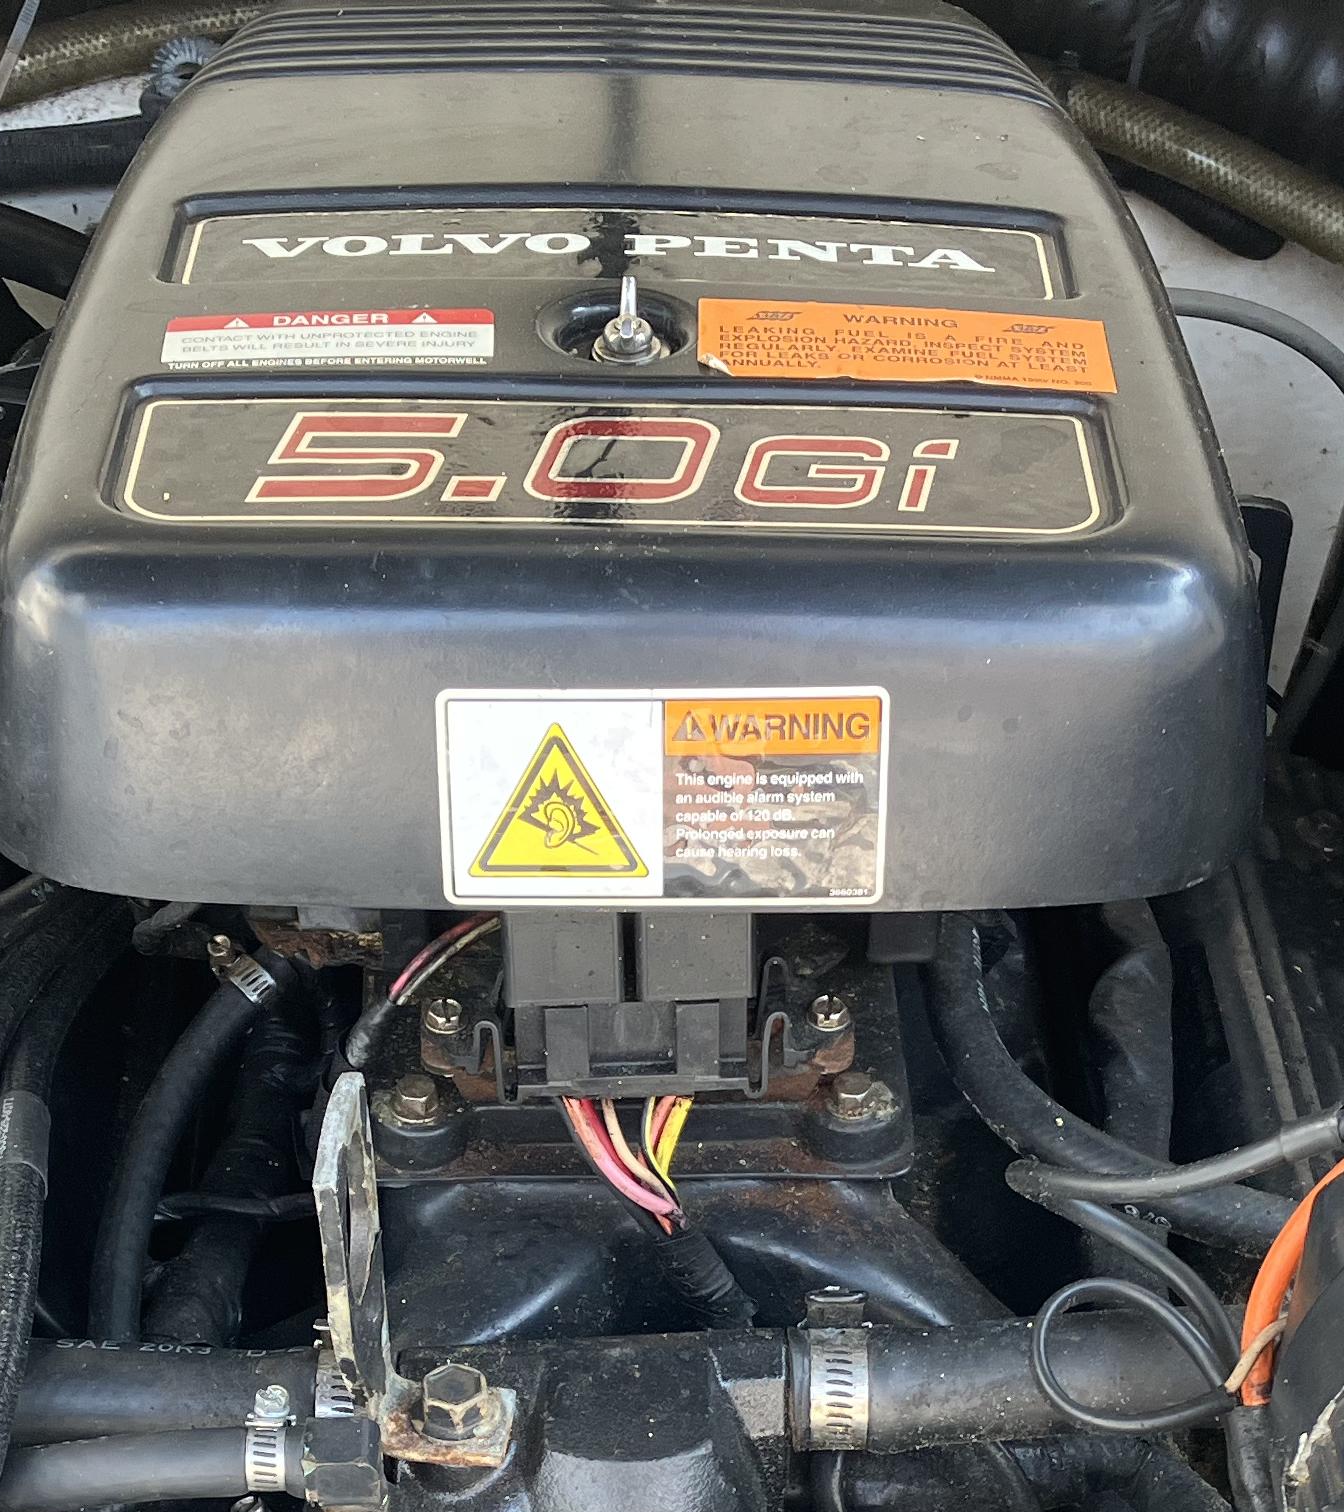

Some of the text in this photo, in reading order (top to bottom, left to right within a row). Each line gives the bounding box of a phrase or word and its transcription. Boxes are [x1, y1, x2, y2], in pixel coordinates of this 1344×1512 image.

[242, 232, 996, 274] VOLVO PENTA
[272, 313, 389, 327] DANGER
[842, 313, 959, 329] WARNING
[181, 330, 478, 345] CONTACT WITH UNPROTECTED ENGINE
[718, 325, 1085, 350] LEAKING FUEL IS A FIRE AND
[719, 333, 828, 346] EXPLOSION
[924, 341, 1002, 353] INSPECT
[1008, 345, 1087, 358] SYSTEM
[181, 339, 476, 354] BELTS WILL RESULT IN SEVERE INJURY
[167, 356, 488, 371] TURN OFF ALL ENGINES BEFORE ENTERING MOTORWELL
[719, 350, 1089, 374] FOR LEAKS OR CORROSION AT LEAST
[850, 346, 949, 357] EXAMINE
[951, 349, 998, 361] FUEL
[1008, 354, 1088, 366] SYSTEM
[708, 711, 871, 743] WARNING
[674, 770, 865, 789] This engine is equipped with
[675, 790, 836, 805] an audible alarm system
[675, 808, 796, 826] capable of 120 dB.
[675, 827, 835, 844] Prolonged exposure can
[675, 845, 802, 860] cause hearing loss.
[55, 1337, 122, 1352] SAE
